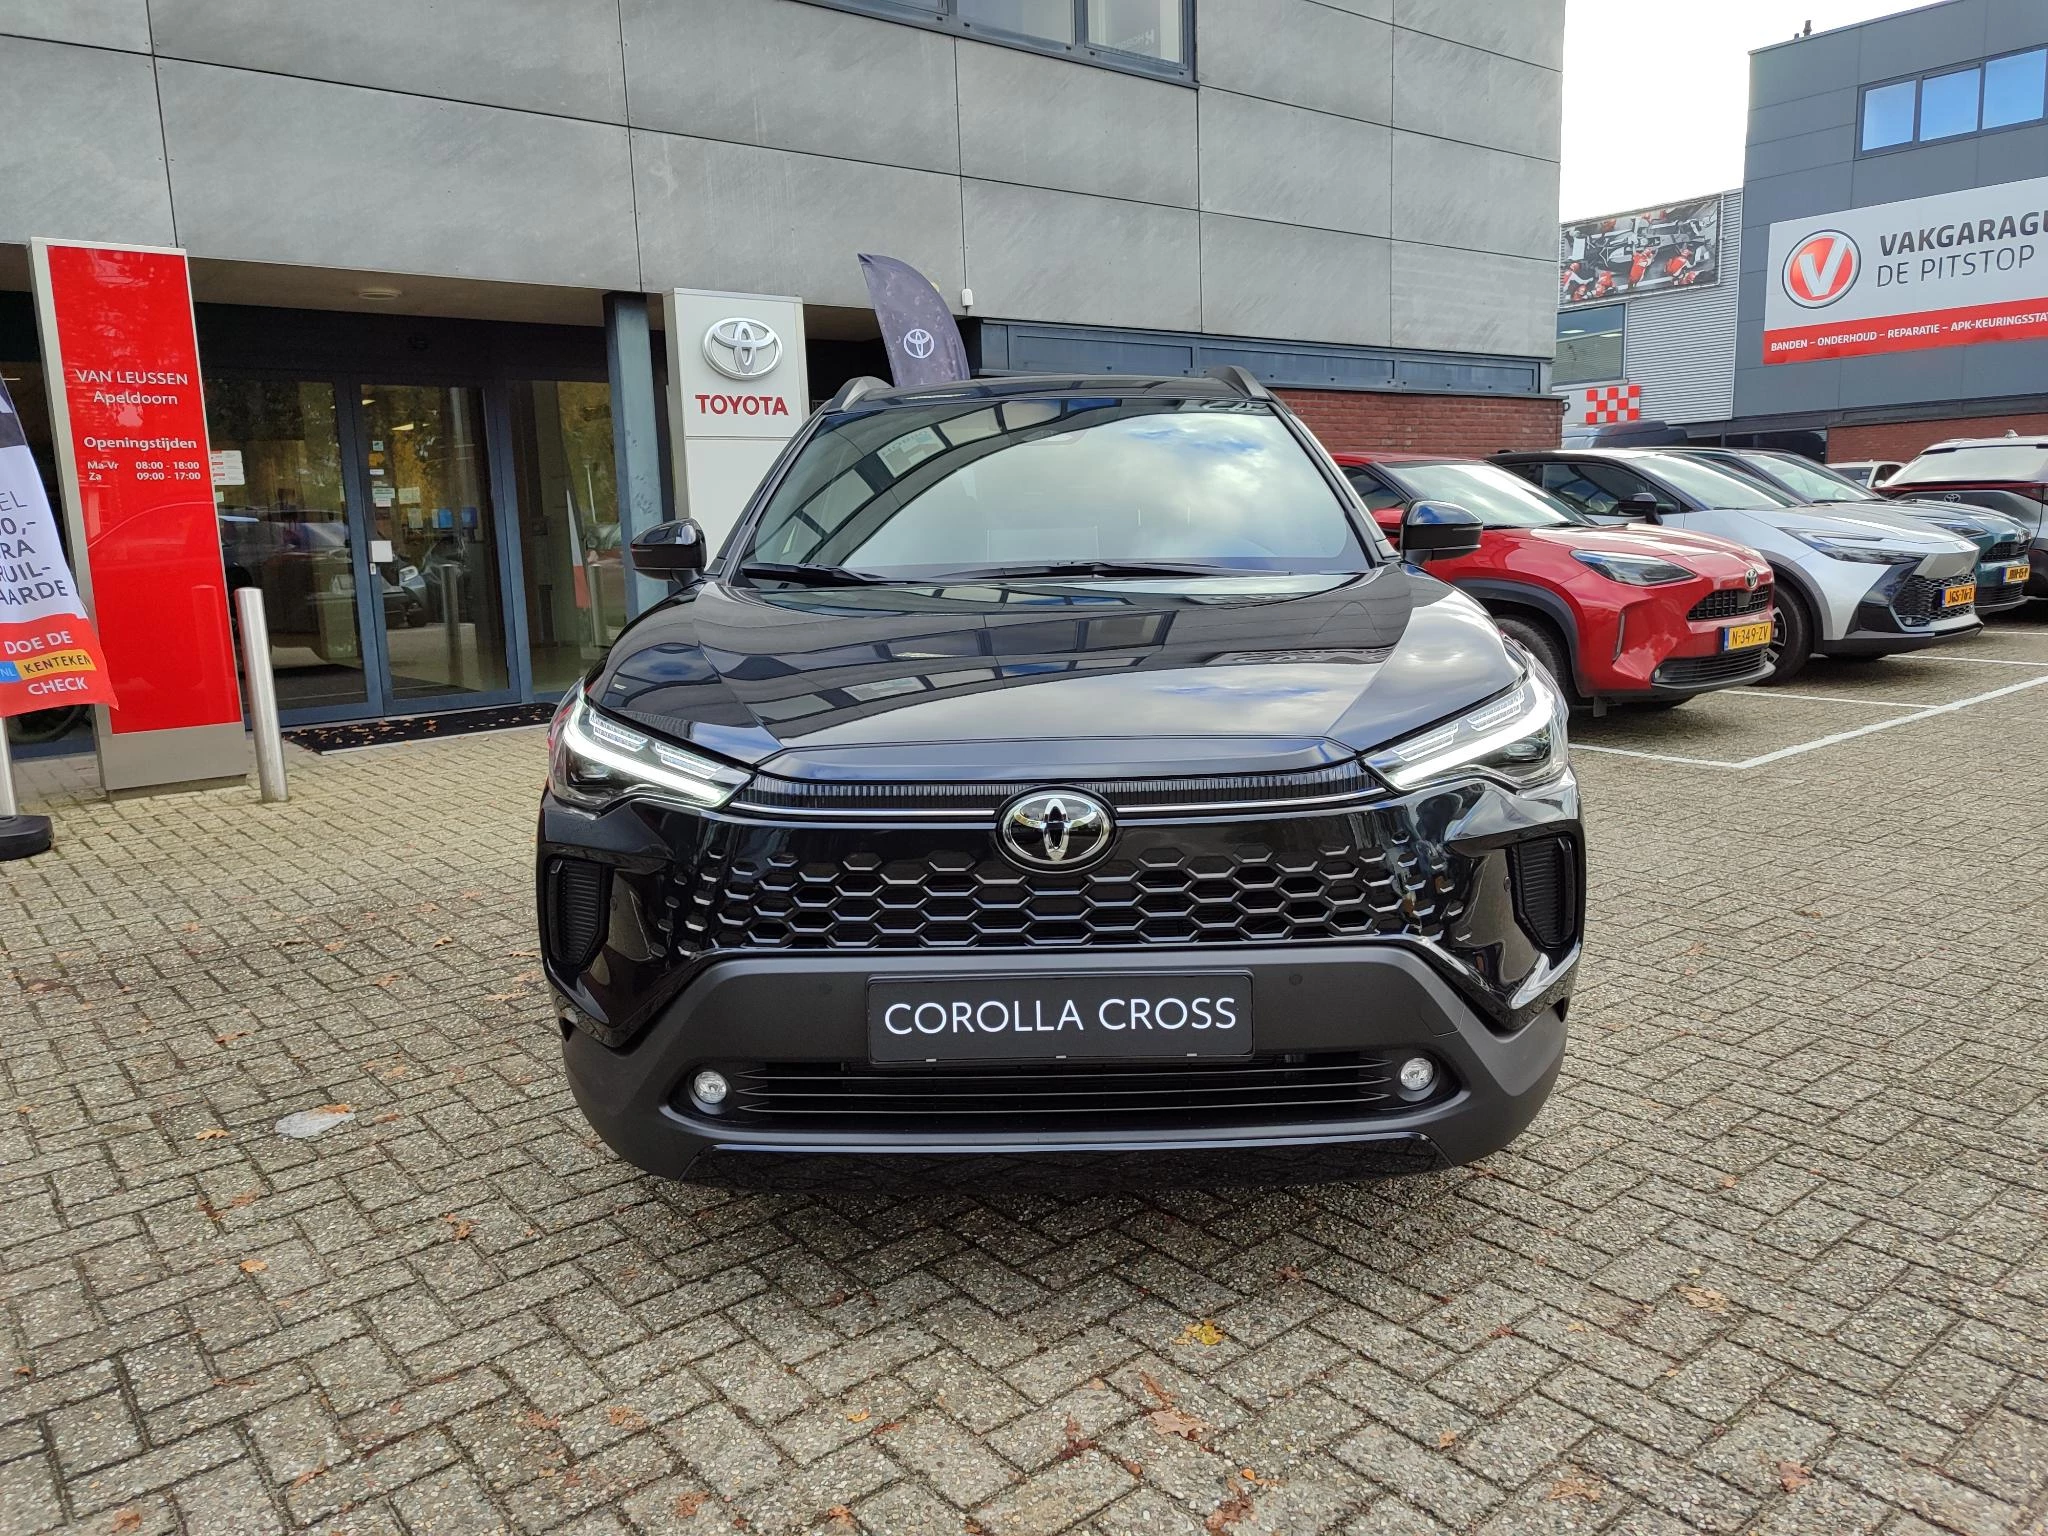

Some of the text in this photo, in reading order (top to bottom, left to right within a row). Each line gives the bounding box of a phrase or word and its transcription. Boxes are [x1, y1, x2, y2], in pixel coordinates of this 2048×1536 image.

[1877, 245, 2035, 288] DE PITSTOP
[1771, 339, 1808, 352] BANDEN
[1817, 331, 1877, 347] ONDERHOUD
[1887, 324, 1940, 339] REPARATIE
[1950, 311, 2048, 332] APK-KEURINGSSTA
[75, 368, 188, 385] VAN LEUSSEN
[93, 391, 178, 405] Apeldoorn
[695, 394, 789, 416] TOYOTA
[83, 437, 197, 451] Openingstijden
[87, 461, 119, 470] Ma-Vr
[135, 461, 164, 470] 08:00
[173, 461, 200, 470] 18:00
[88, 472, 102, 481] Za
[136, 472, 165, 481] 09:00
[174, 472, 201, 481] 17:00
[4, 630, 73, 654] DOE DE
[1731, 626, 1769, 645] N-349-ZV
[24, 654, 91, 674] KENTEKEN
[27, 677, 89, 695] CHECK
[884, 997, 1237, 1035] COROLLA CROSS
